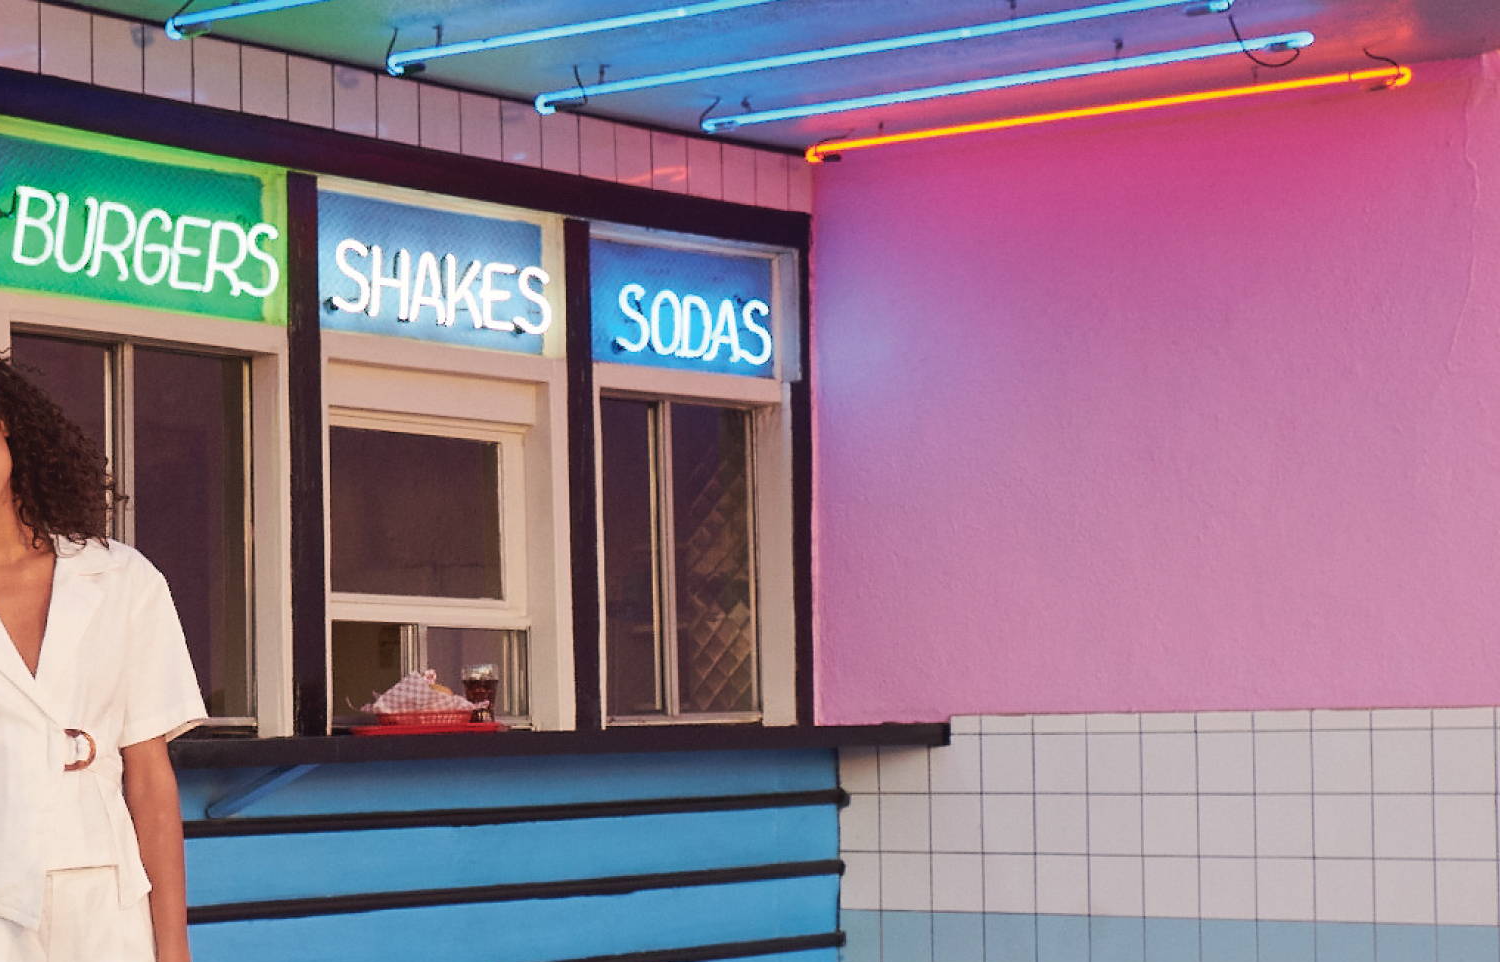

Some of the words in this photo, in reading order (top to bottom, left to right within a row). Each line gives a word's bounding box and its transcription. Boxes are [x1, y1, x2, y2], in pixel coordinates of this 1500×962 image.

[11, 185, 280, 298] BURGERS
[331, 239, 553, 335] SHAKES
[615, 284, 773, 365] SODAS
